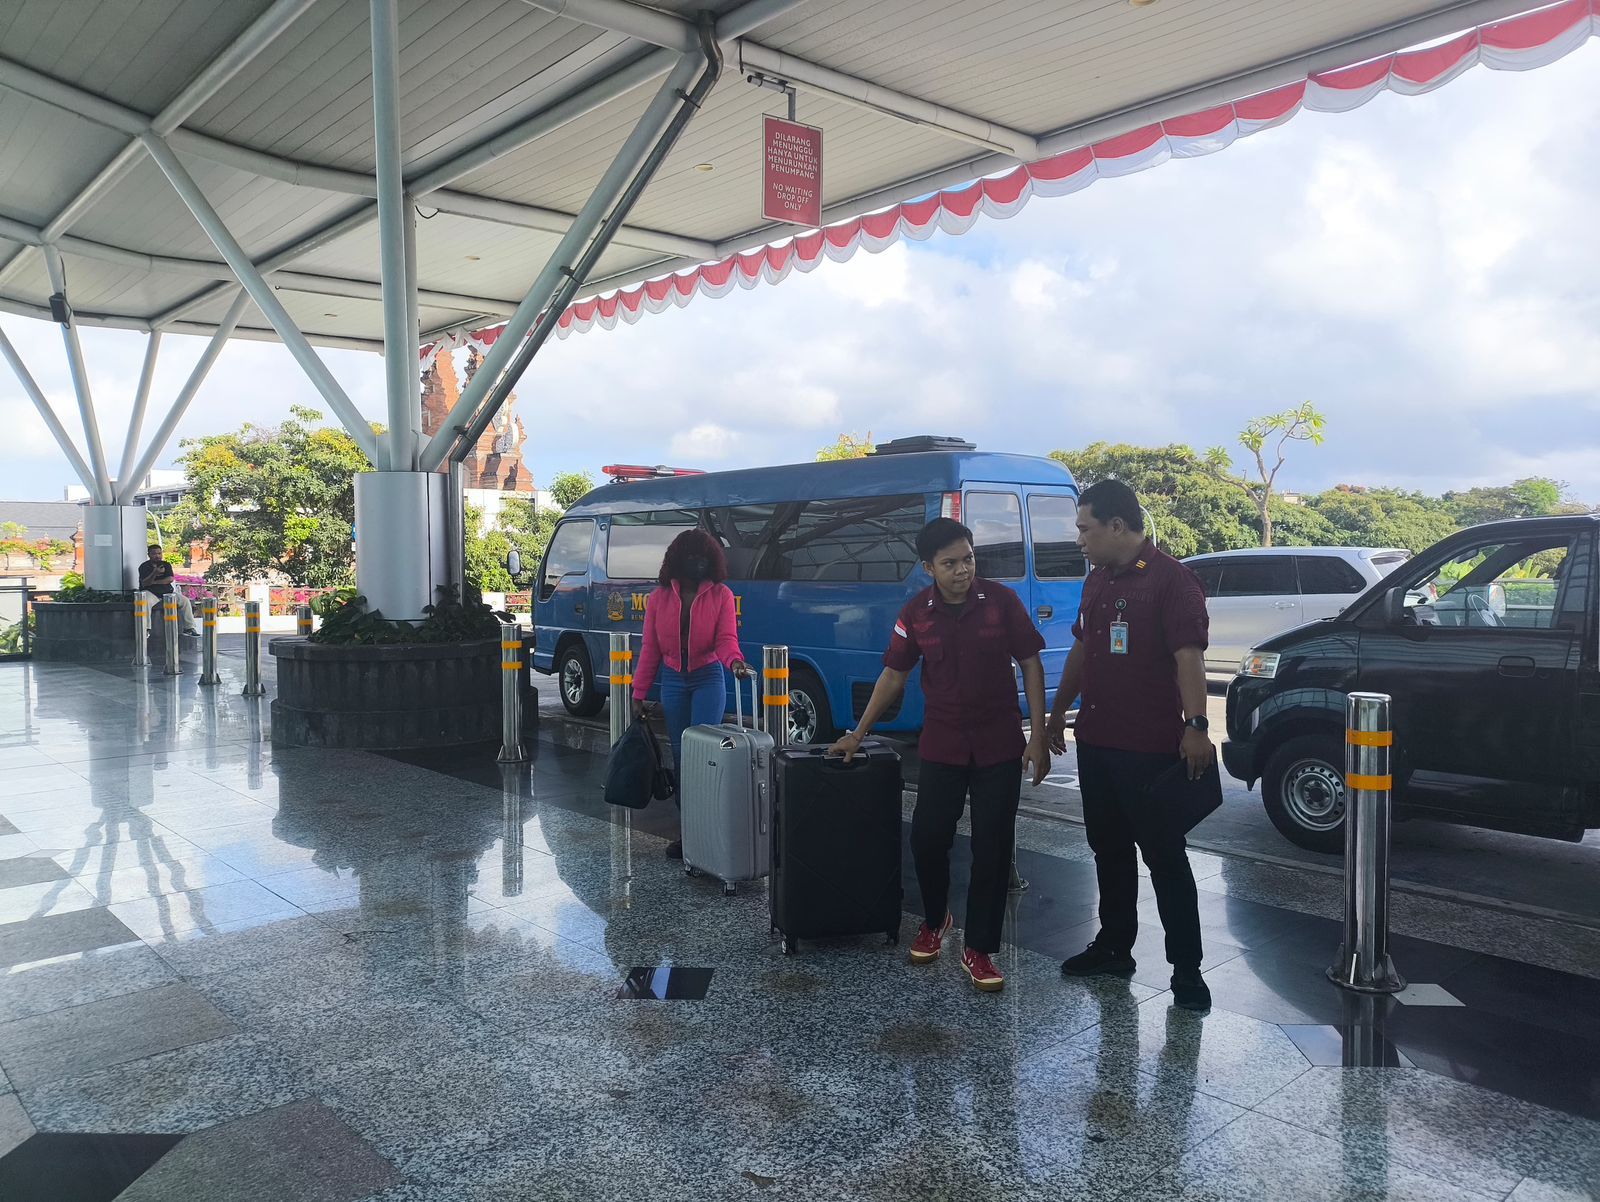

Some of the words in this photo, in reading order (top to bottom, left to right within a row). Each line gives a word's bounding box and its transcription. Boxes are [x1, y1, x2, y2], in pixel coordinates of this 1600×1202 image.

[773, 139, 813, 155] MENUNGGU
[775, 132, 811, 147] DILARANG
[768, 146, 793, 159] HANYA
[794, 152, 818, 165] UNTUK
[768, 155, 818, 172] MENURUNKAN
[771, 163, 814, 179] PENUMPANG
[773, 182, 784, 191] NO
[785, 185, 813, 198] WAITING
[777, 191, 796, 201] DROP
[797, 195, 809, 204] OFF
[784, 201, 802, 211] ONLY
